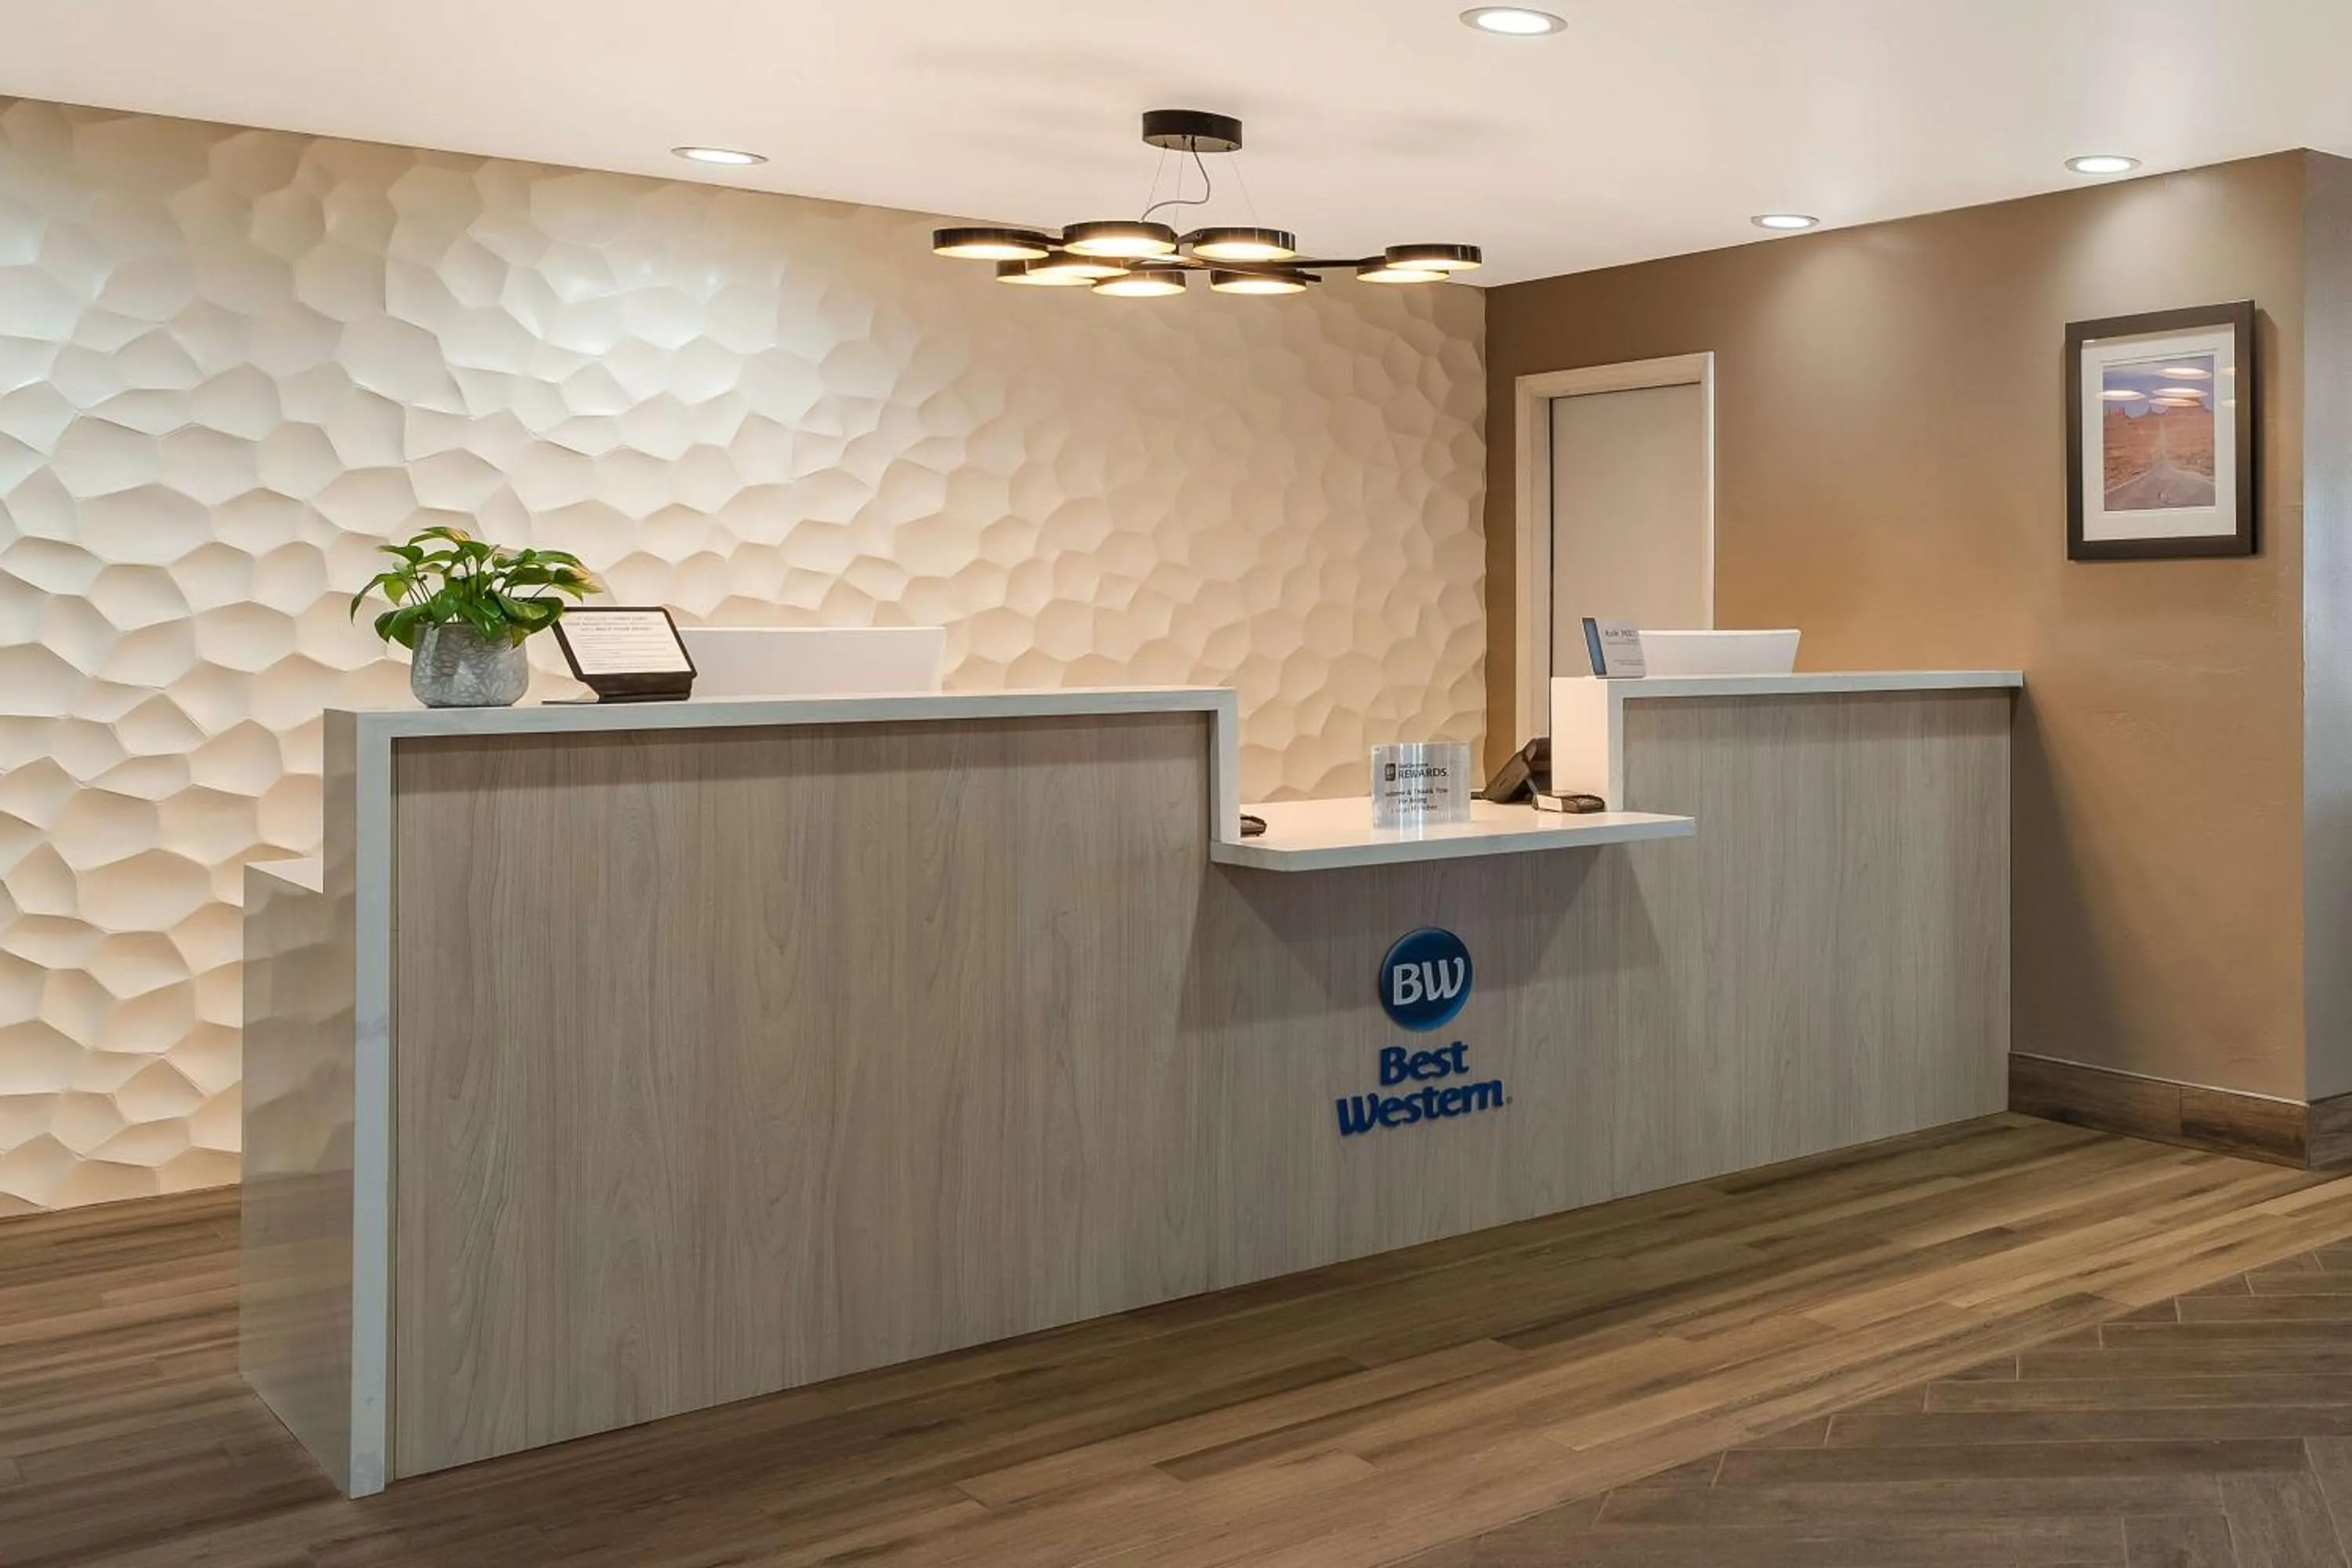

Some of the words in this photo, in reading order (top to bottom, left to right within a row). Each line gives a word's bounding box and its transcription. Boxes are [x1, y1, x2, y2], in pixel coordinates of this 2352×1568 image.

[1398, 768, 1446, 779] REWARDS
[1393, 956, 1465, 1006] BW
[1379, 1040, 1470, 1087] Best
[1336, 1079, 1504, 1137] Western
